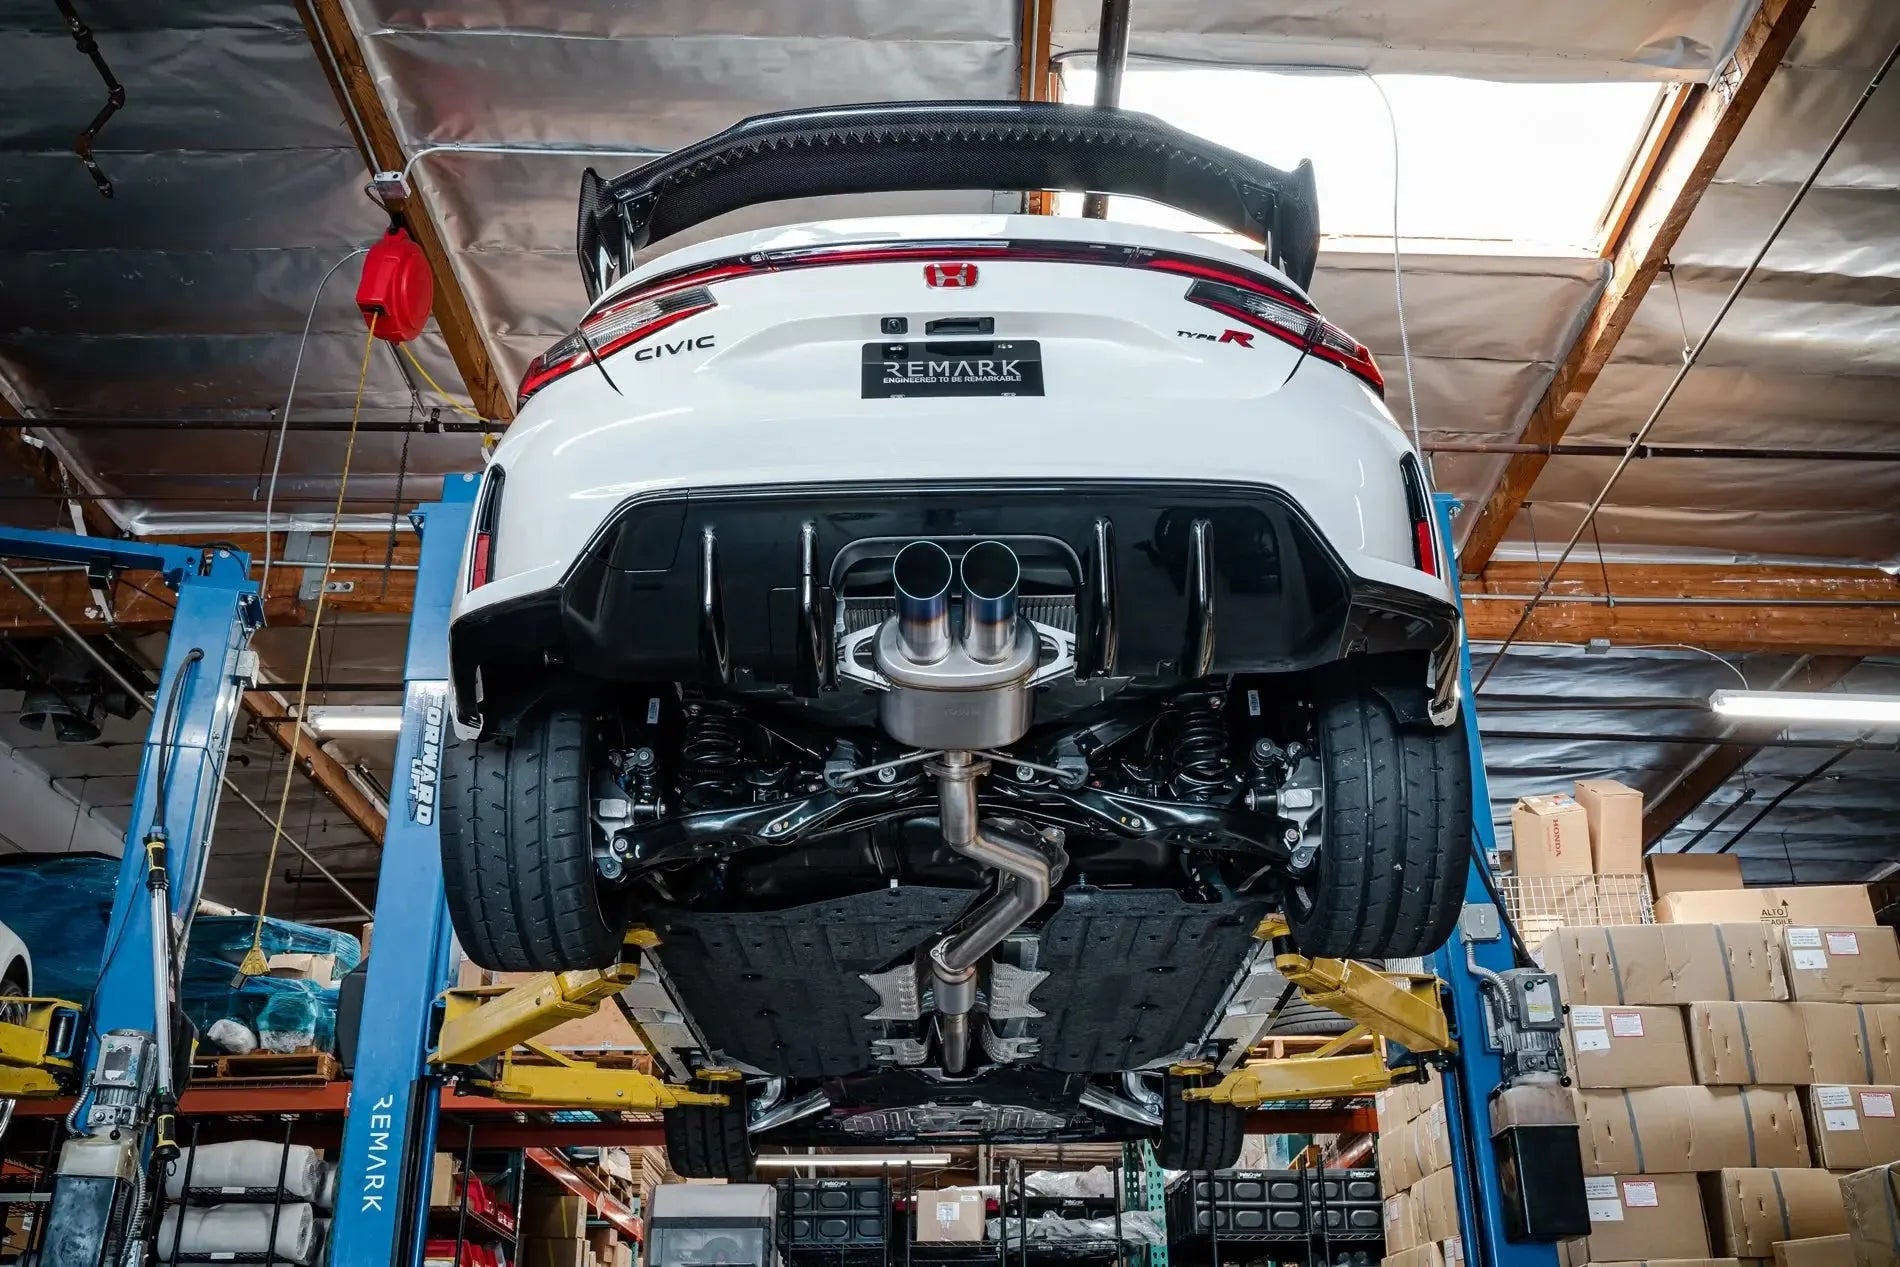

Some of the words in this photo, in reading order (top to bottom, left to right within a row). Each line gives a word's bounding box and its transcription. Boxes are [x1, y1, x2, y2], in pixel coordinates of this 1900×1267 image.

[634, 334, 715, 361] CIVIC
[1177, 330, 1217, 341] TYPE
[1218, 329, 1256, 349] R
[883, 360, 1021, 378] REMARK
[883, 376, 937, 384] ENGINEERED
[964, 375, 1022, 383] REMARKABLE
[409, 757, 424, 804] LIFT
[1553, 819, 1562, 857] HONDA
[1761, 908, 1784, 917] ALTO
[1761, 918, 1793, 926] AGILE
[361, 1094, 394, 1212] REMARK
